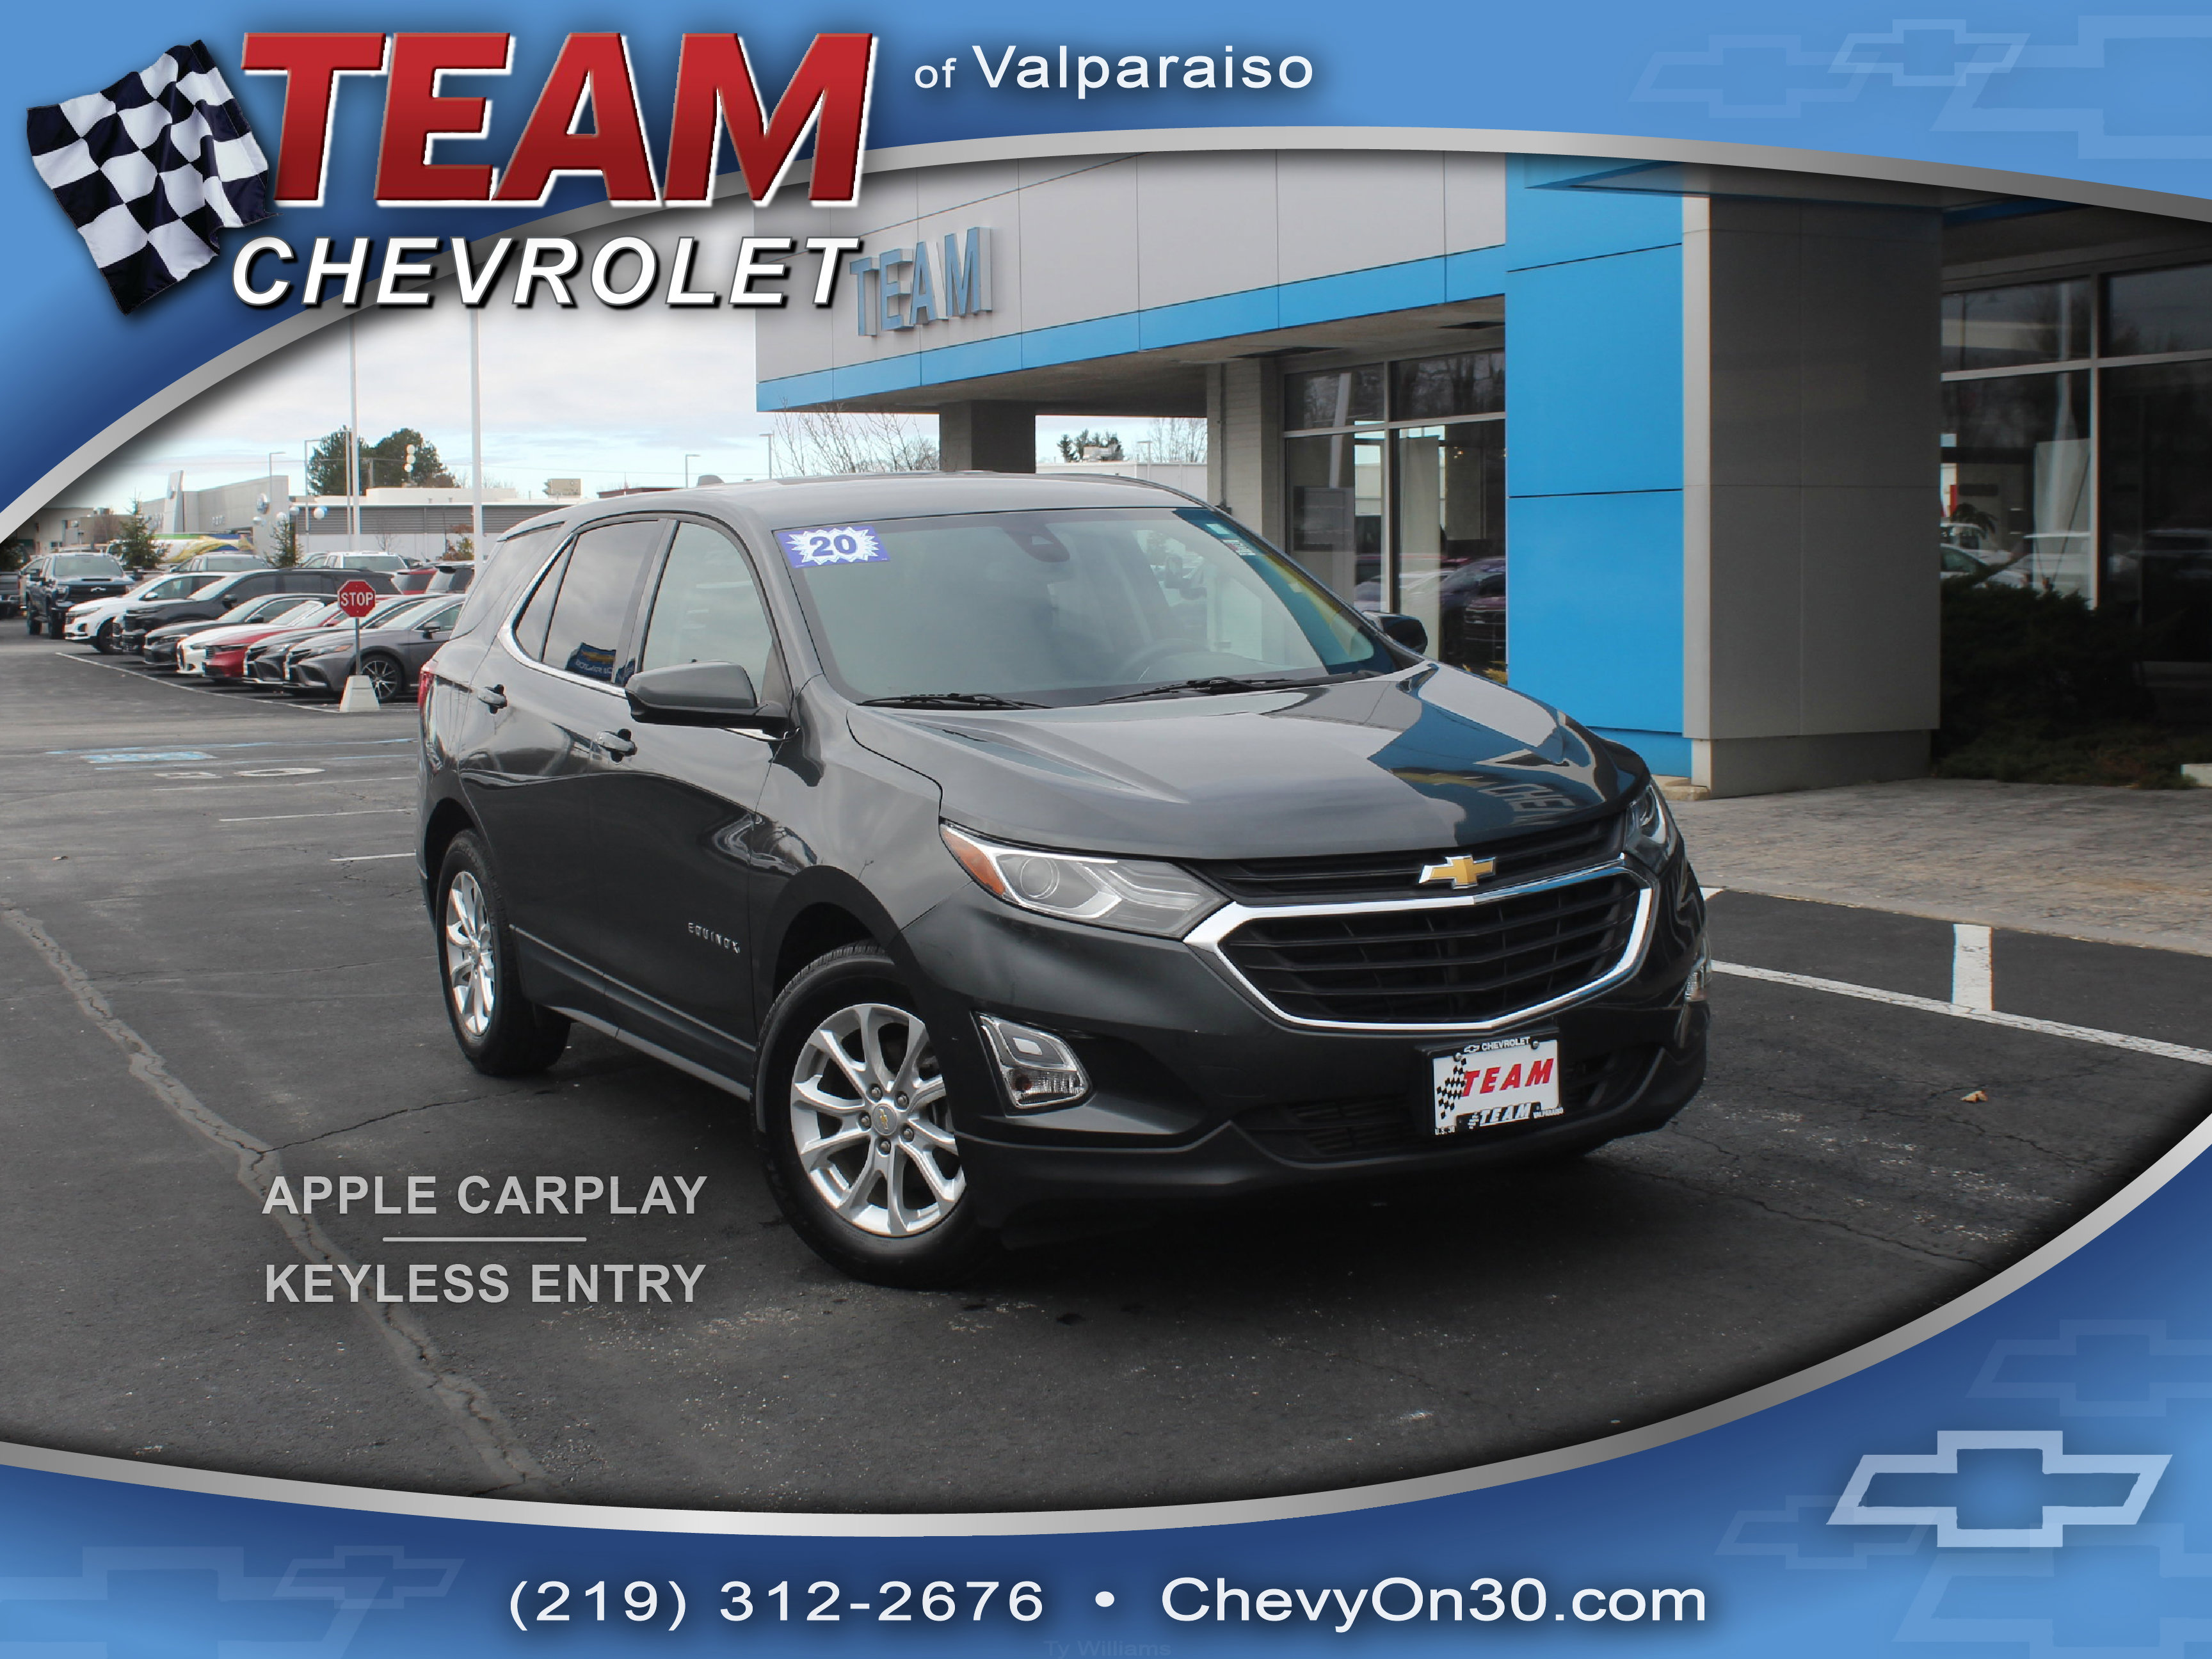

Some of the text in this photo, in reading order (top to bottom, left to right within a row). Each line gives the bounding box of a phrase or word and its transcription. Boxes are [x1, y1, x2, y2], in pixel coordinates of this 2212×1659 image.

[849, 227, 992, 336] TEAM
[810, 534, 857, 557] 20
[341, 592, 373, 606] STOP
[688, 922, 741, 954] EQUINOX
[1481, 1036, 1530, 1052] CHEVROLET
[1461, 1058, 1554, 1097] TEAM
[1480, 1102, 1531, 1125] TEAM
